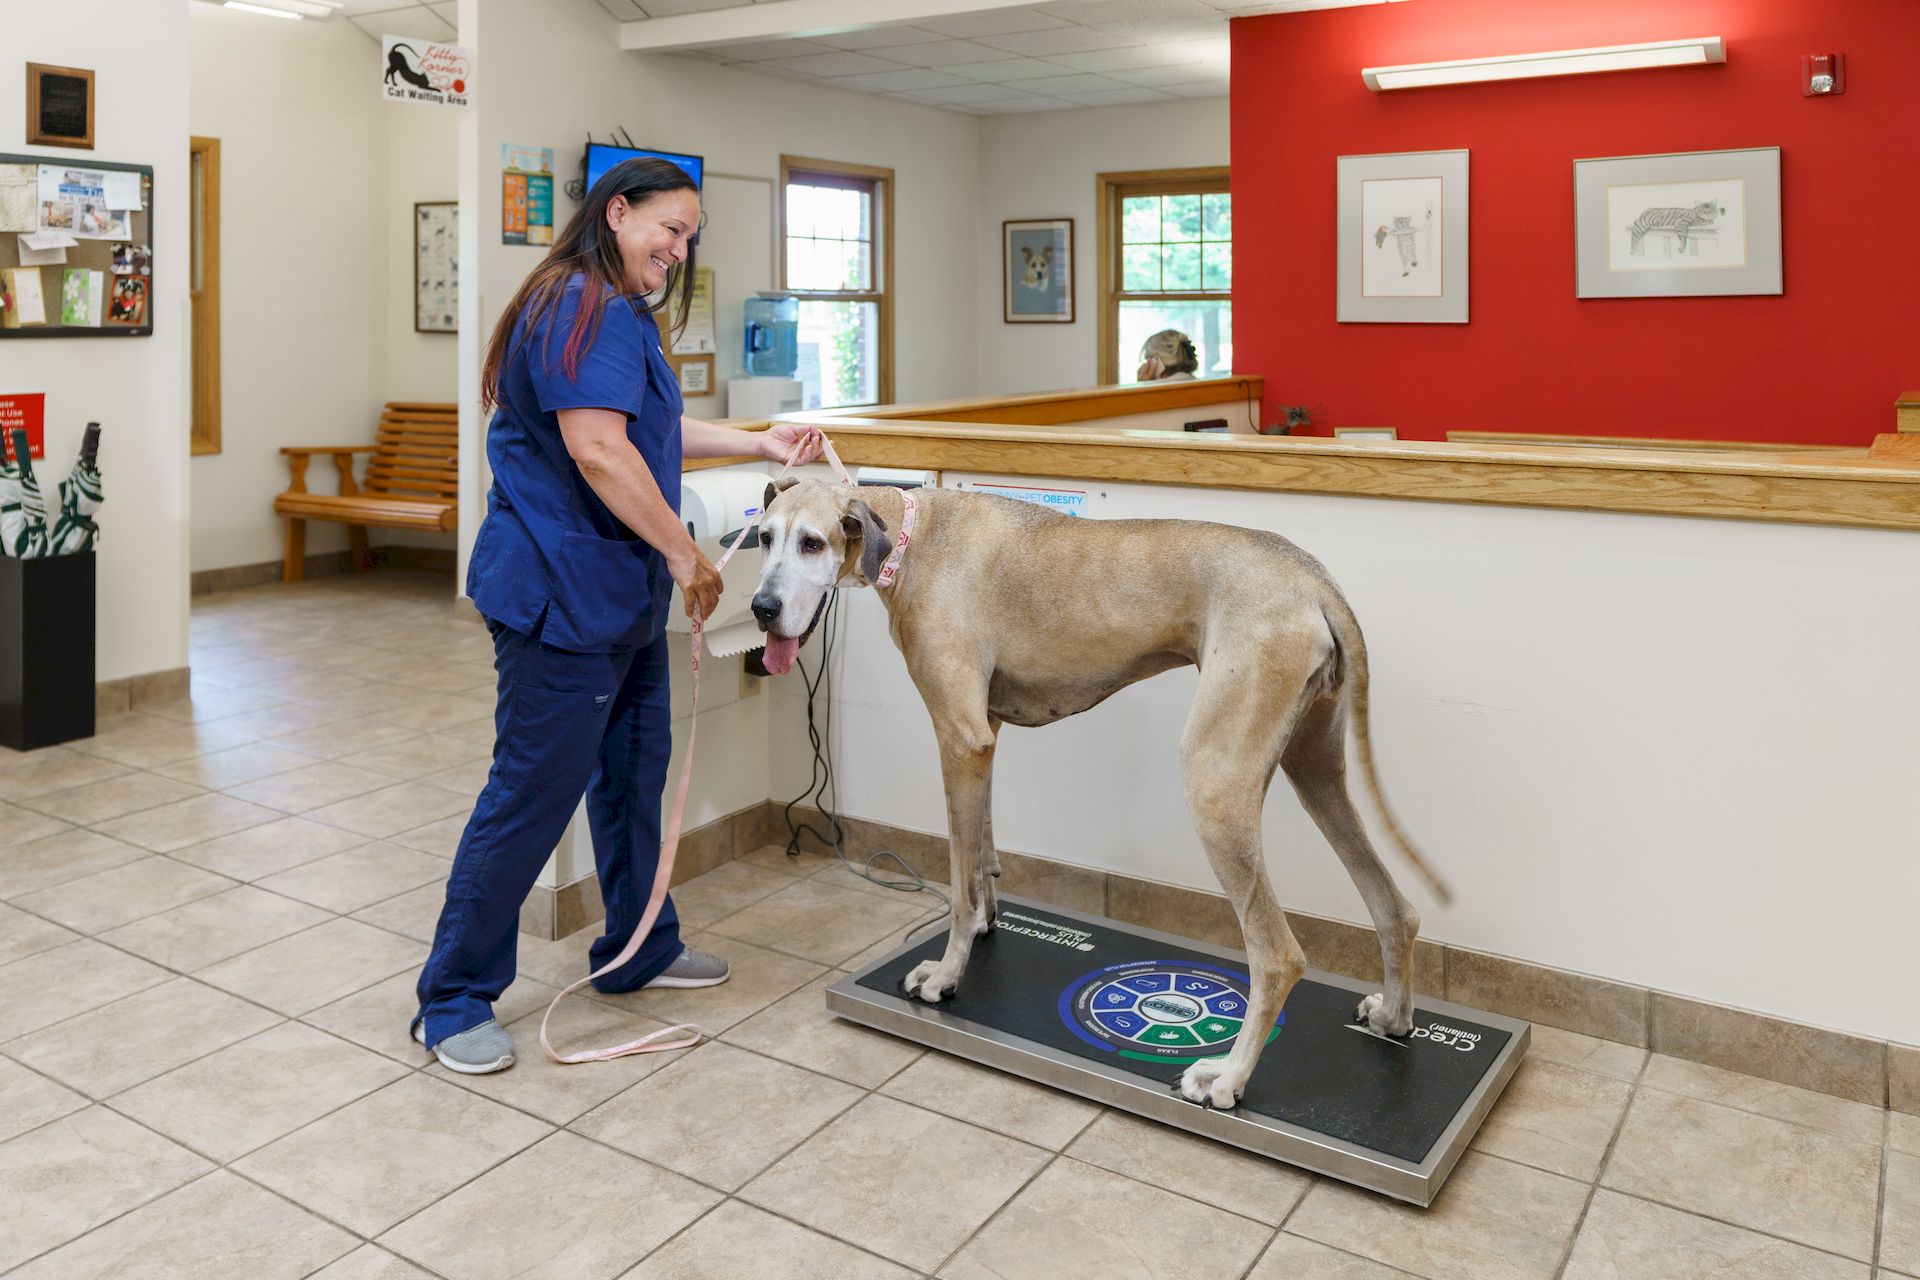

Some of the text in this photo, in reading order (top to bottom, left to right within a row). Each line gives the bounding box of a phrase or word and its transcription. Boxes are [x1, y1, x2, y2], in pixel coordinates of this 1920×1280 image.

[423, 45, 459, 65] Kitty
[417, 58, 464, 75] Korner
[388, 87, 467, 106] Cat Waiting Area
[0, 418, 25, 427] hones
[7, 409, 23, 418] Use
[1026, 493, 1042, 503] PET
[1043, 494, 1083, 505] OBESITY
[994, 920, 1080, 949] INTERCEPTO
[1058, 931, 1085, 943] PLUS
[1409, 1027, 1475, 1052] Cred
[1429, 1023, 1481, 1042] (lotilaner)
